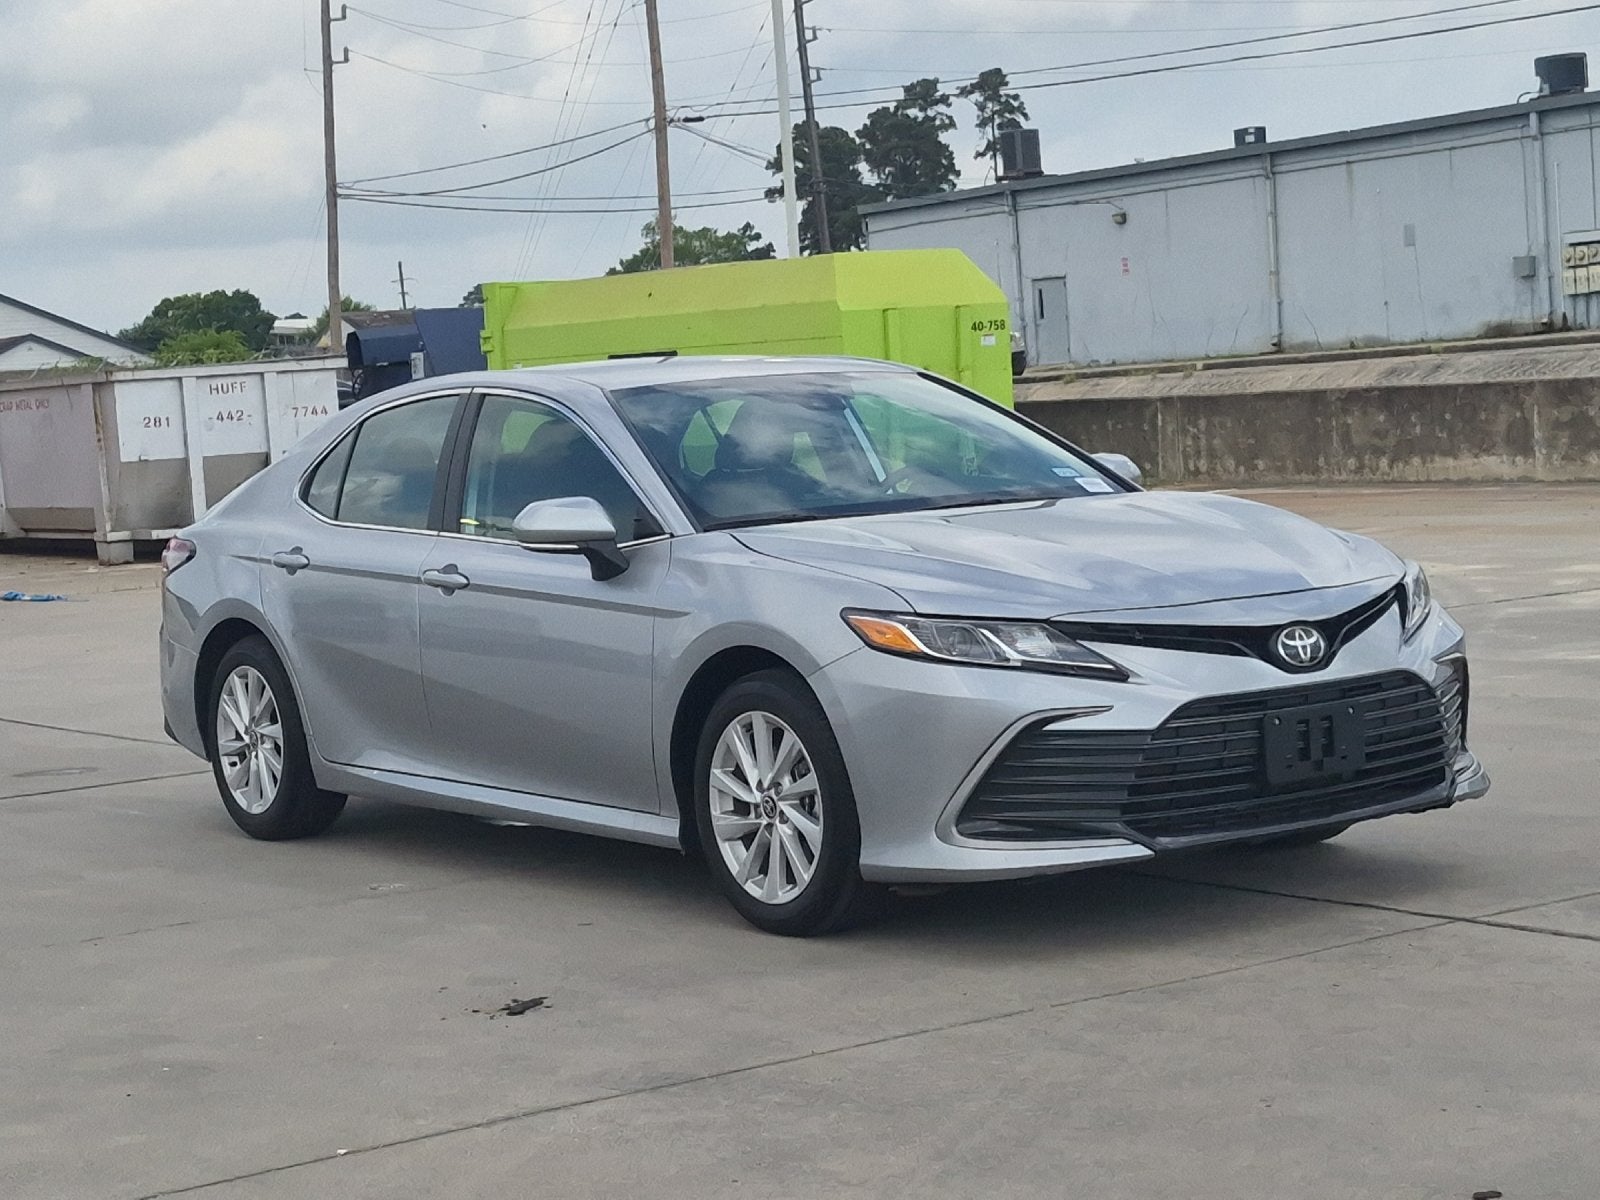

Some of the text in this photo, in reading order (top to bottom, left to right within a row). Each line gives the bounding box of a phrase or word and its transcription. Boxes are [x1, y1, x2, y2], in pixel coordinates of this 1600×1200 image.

[971, 319, 1006, 332] 40-758
[208, 381, 247, 395] HUFF
[142, 416, 170, 428] 281
[291, 405, 328, 418] 7744
